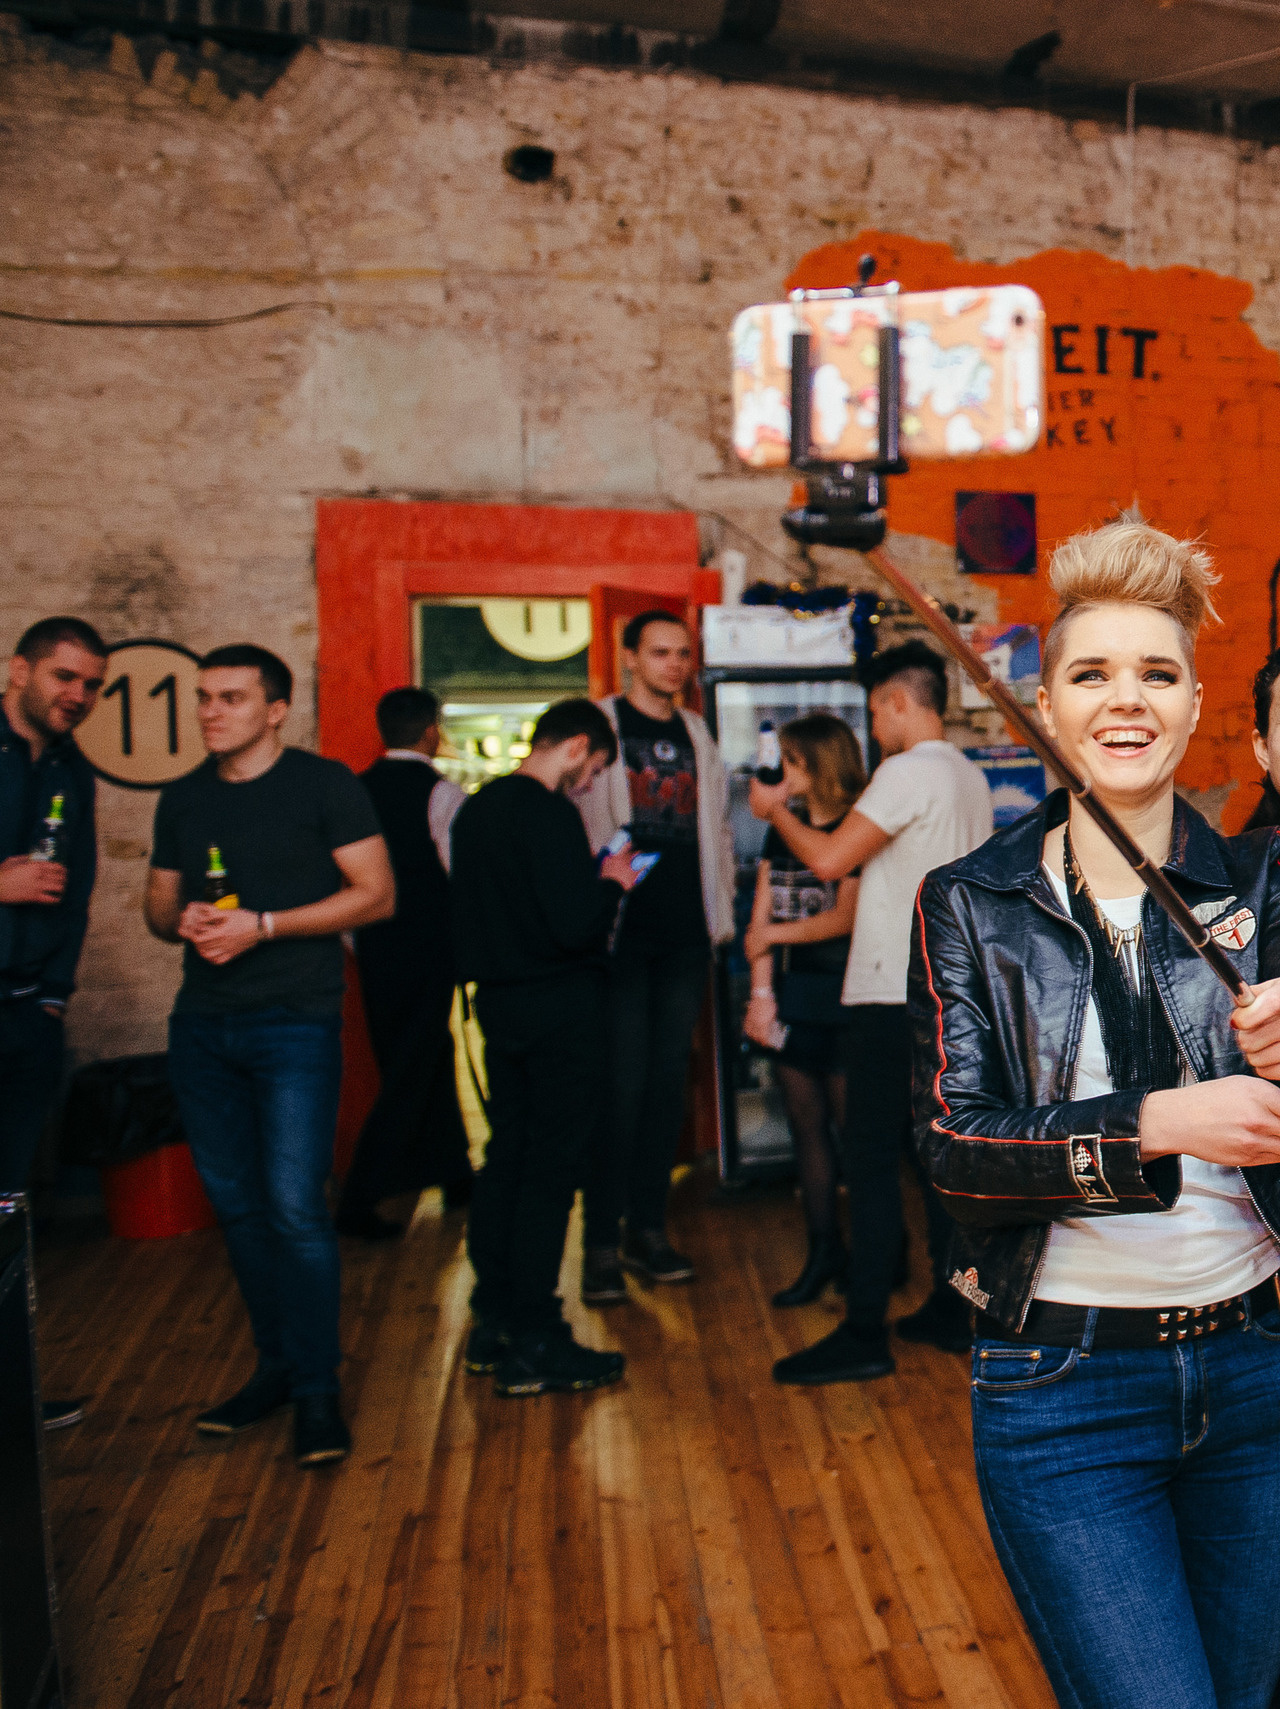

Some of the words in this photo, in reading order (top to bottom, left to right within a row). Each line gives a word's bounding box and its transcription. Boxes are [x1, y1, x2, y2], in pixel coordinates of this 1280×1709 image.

[103, 673, 178, 756] 11
[1211, 922, 1229, 935] THE
[1230, 909, 1251, 928] FIRST
[1228, 928, 1244, 947] 1
